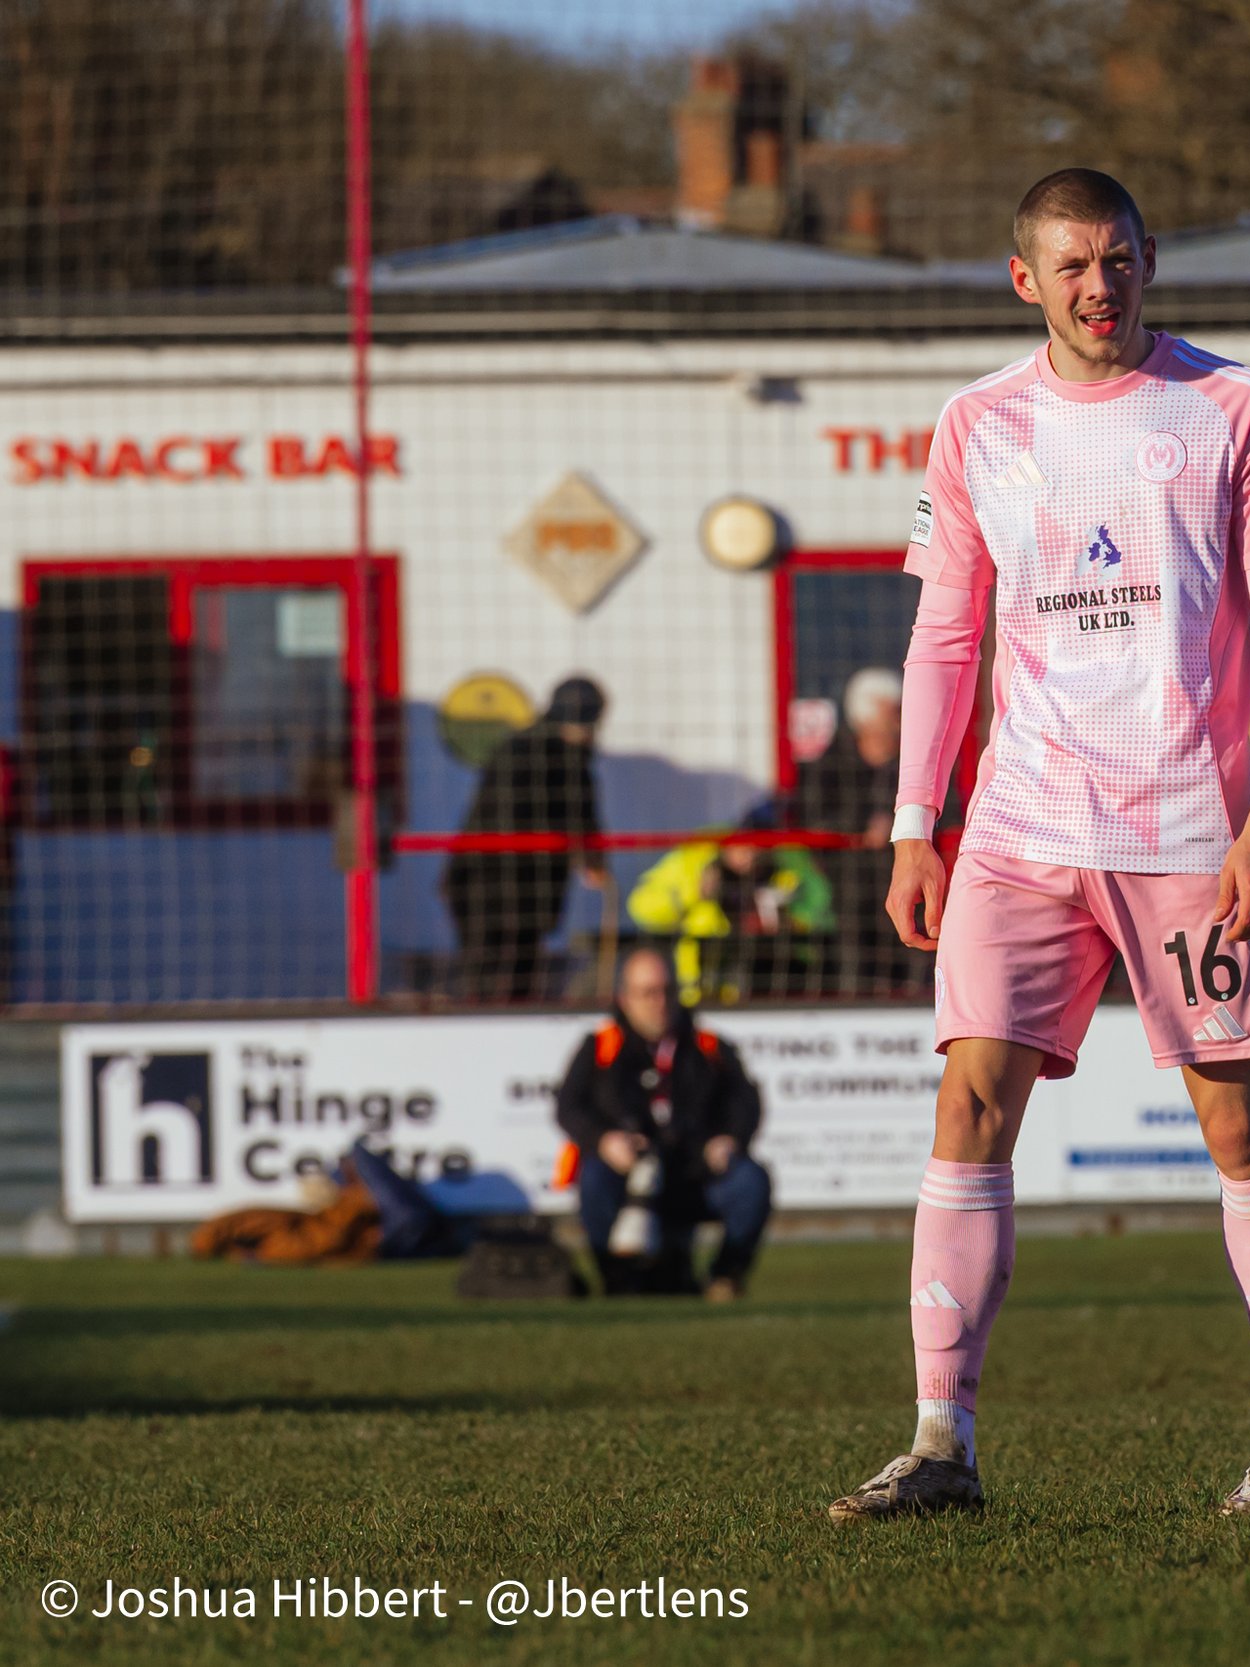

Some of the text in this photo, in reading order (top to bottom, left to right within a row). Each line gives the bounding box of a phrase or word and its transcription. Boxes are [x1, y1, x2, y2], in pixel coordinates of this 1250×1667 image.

[10, 434, 404, 485] SNACK BAR
[1036, 584, 1162, 614] REGIONAL STEELS
[1078, 611, 1135, 632] UK LTD.
[1163, 924, 1242, 1007] 16
[238, 1045, 309, 1070] The
[240, 1079, 439, 1135] Hinge
